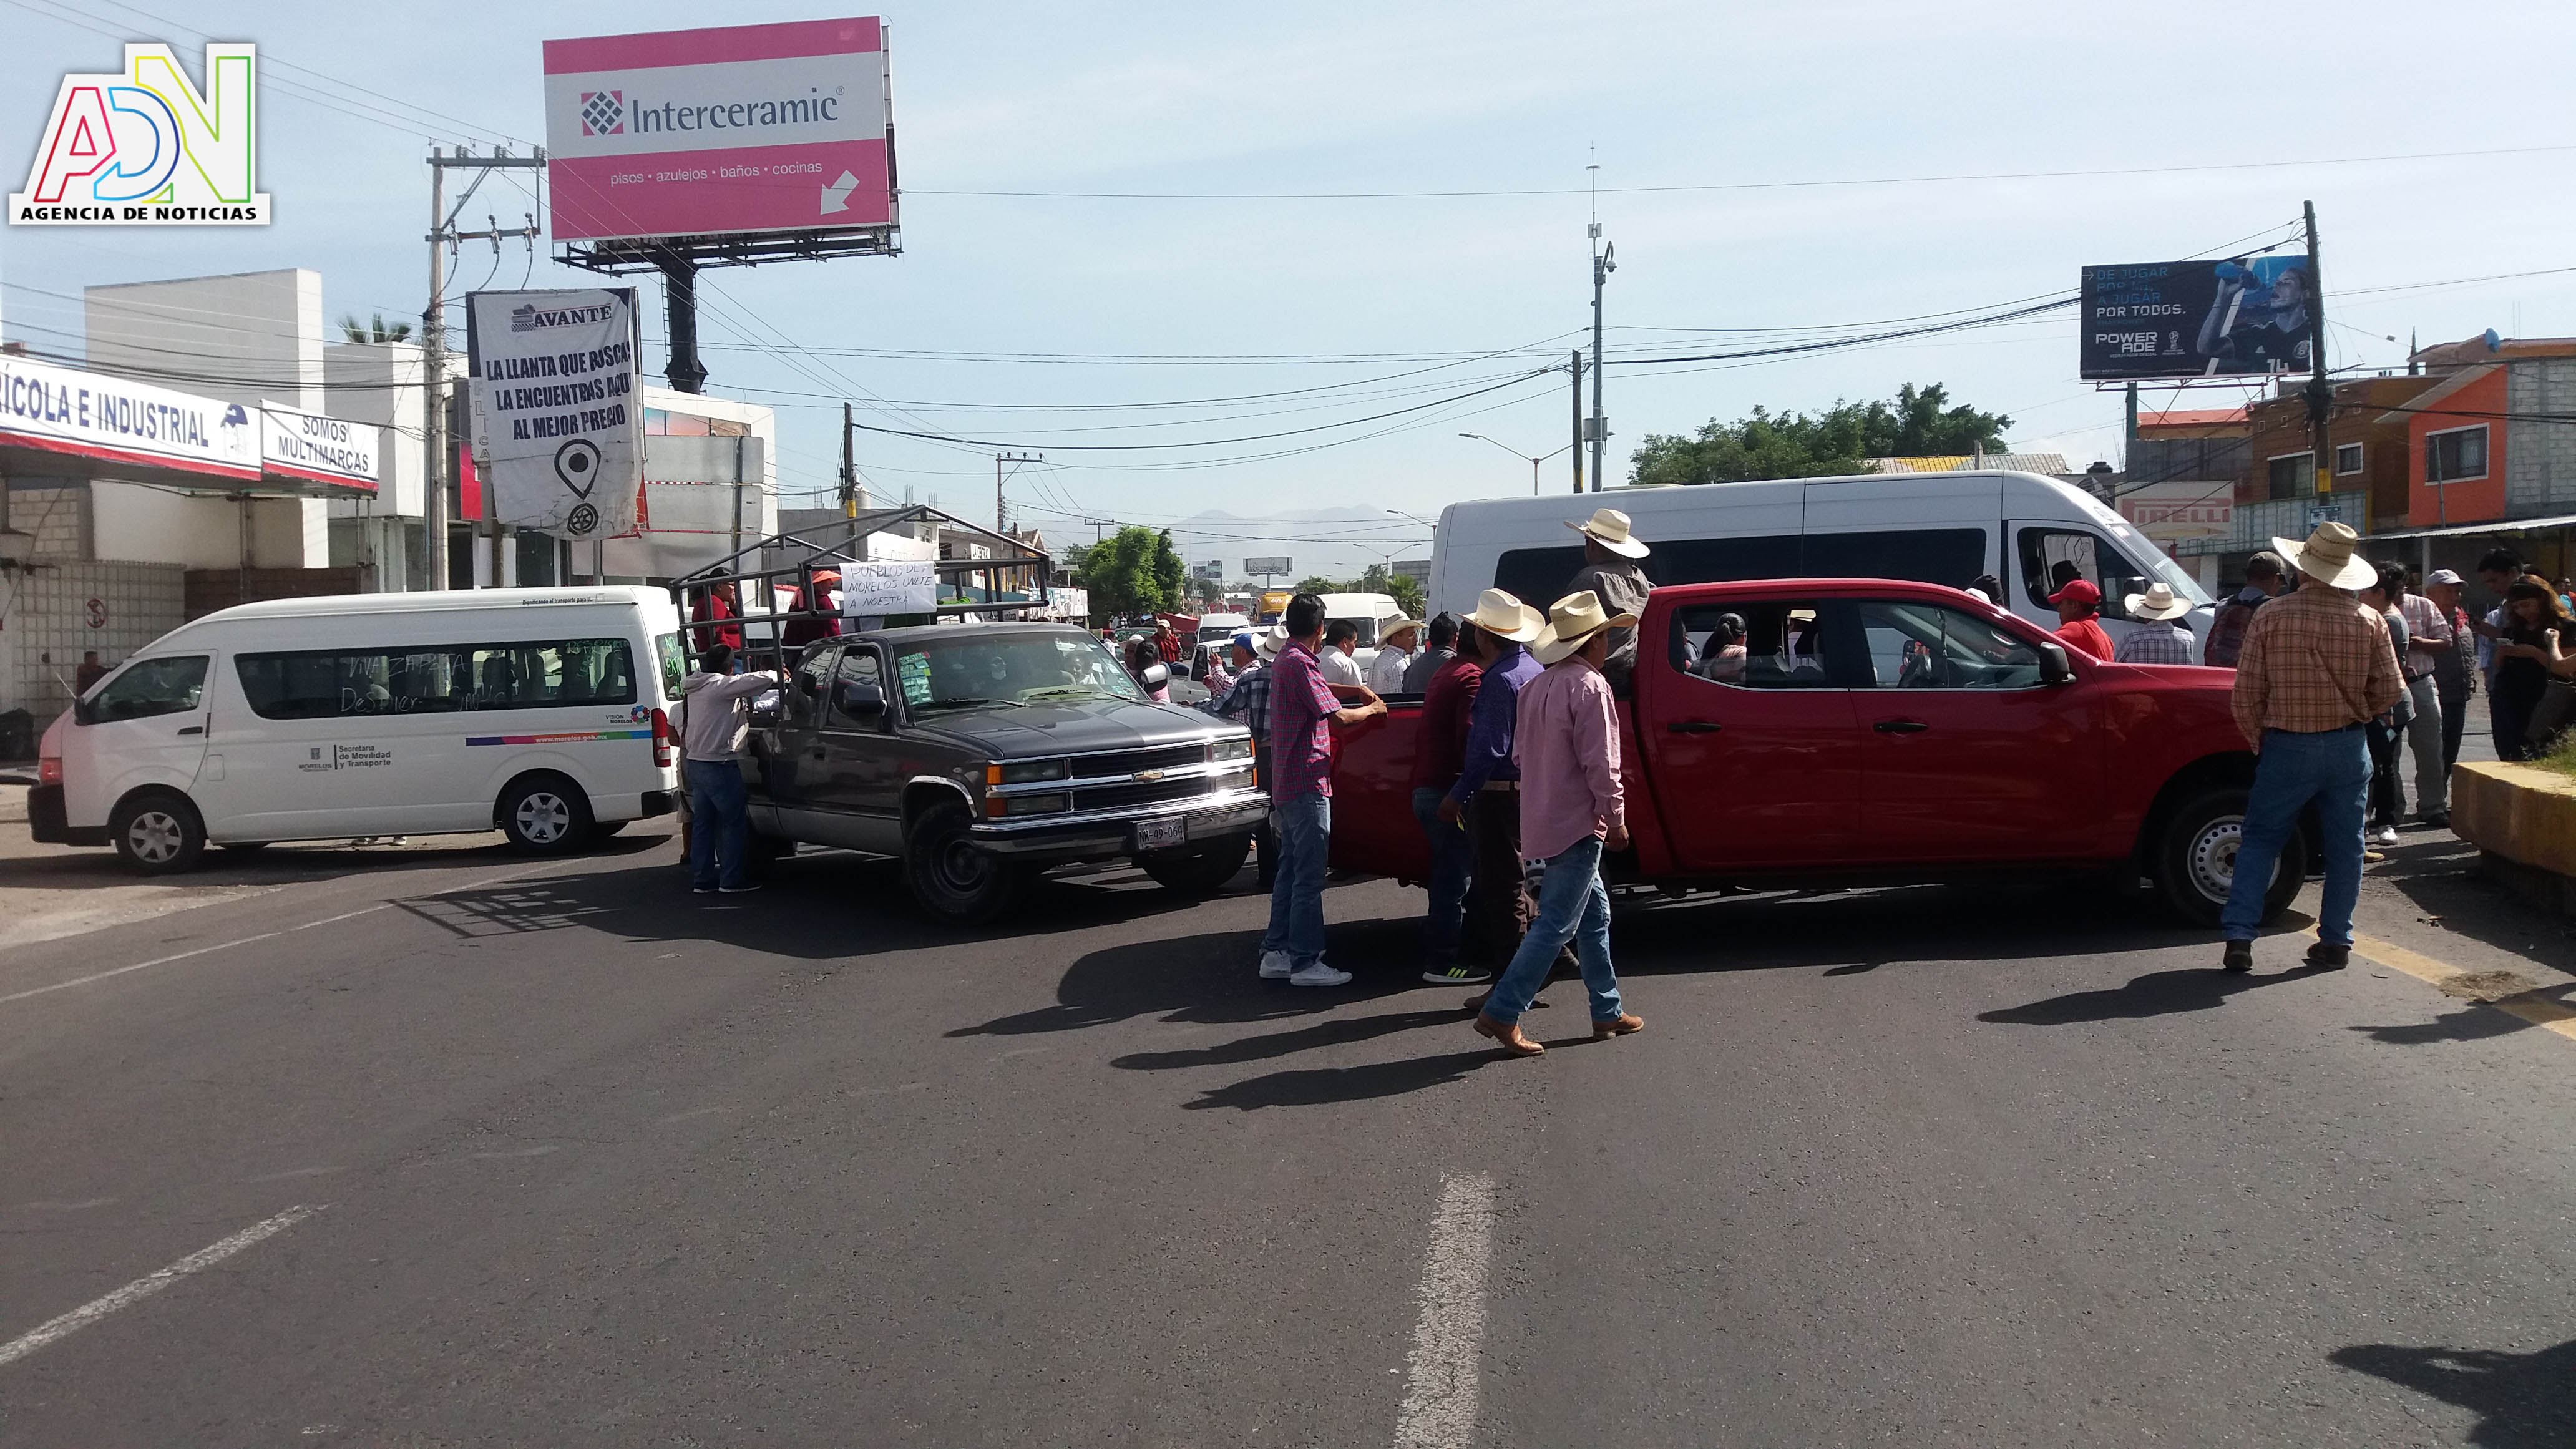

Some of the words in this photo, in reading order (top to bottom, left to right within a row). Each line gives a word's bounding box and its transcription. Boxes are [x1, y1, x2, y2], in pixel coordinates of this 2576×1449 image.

[632, 87, 839, 134] Interceramic
[610, 172, 645, 187] pisos
[656, 168, 708, 182] azulejos
[720, 165, 759, 178] baños
[772, 161, 822, 175] cocinas
[2097, 270, 2115, 280] DE
[2121, 267, 2167, 279] JUGAR
[2098, 296, 2107, 305] A
[2112, 292, 2161, 305] JUGAR
[534, 305, 612, 327] AVANTE
[2097, 306, 2126, 318] POR
[2131, 303, 2187, 316] TODOS.
[2095, 331, 2158, 344] POWER
[2122, 342, 2155, 353] ADE
[486, 359, 504, 381] LA
[505, 356, 557, 379] LLANTA
[559, 352, 587, 378] QUE
[495, 389, 514, 411] LA
[515, 378, 605, 409] ENCUENTRAS
[79, 388, 90, 427] E
[97, 393, 209, 447] INDUSTRIAL
[513, 419, 530, 440] AL
[532, 414, 579, 439] MEJOR
[580, 404, 626, 433] PRECIO
[303, 416, 347, 443] SOMOS
[278, 436, 369, 472] MULTIMARCAS
[2122, 499, 2232, 523] PIRELLI
[850, 564, 902, 579] PUEBLOS
[906, 563, 919, 573] DE
[849, 580, 897, 593] MORELOS
[849, 598, 856, 608] A
[664, 636, 677, 653] NO
[535, 734, 608, 743] www.morelos.gob.mx
[351, 751, 391, 759] Movilidad
[339, 761, 345, 769] y
[347, 759, 391, 768] Transporte
